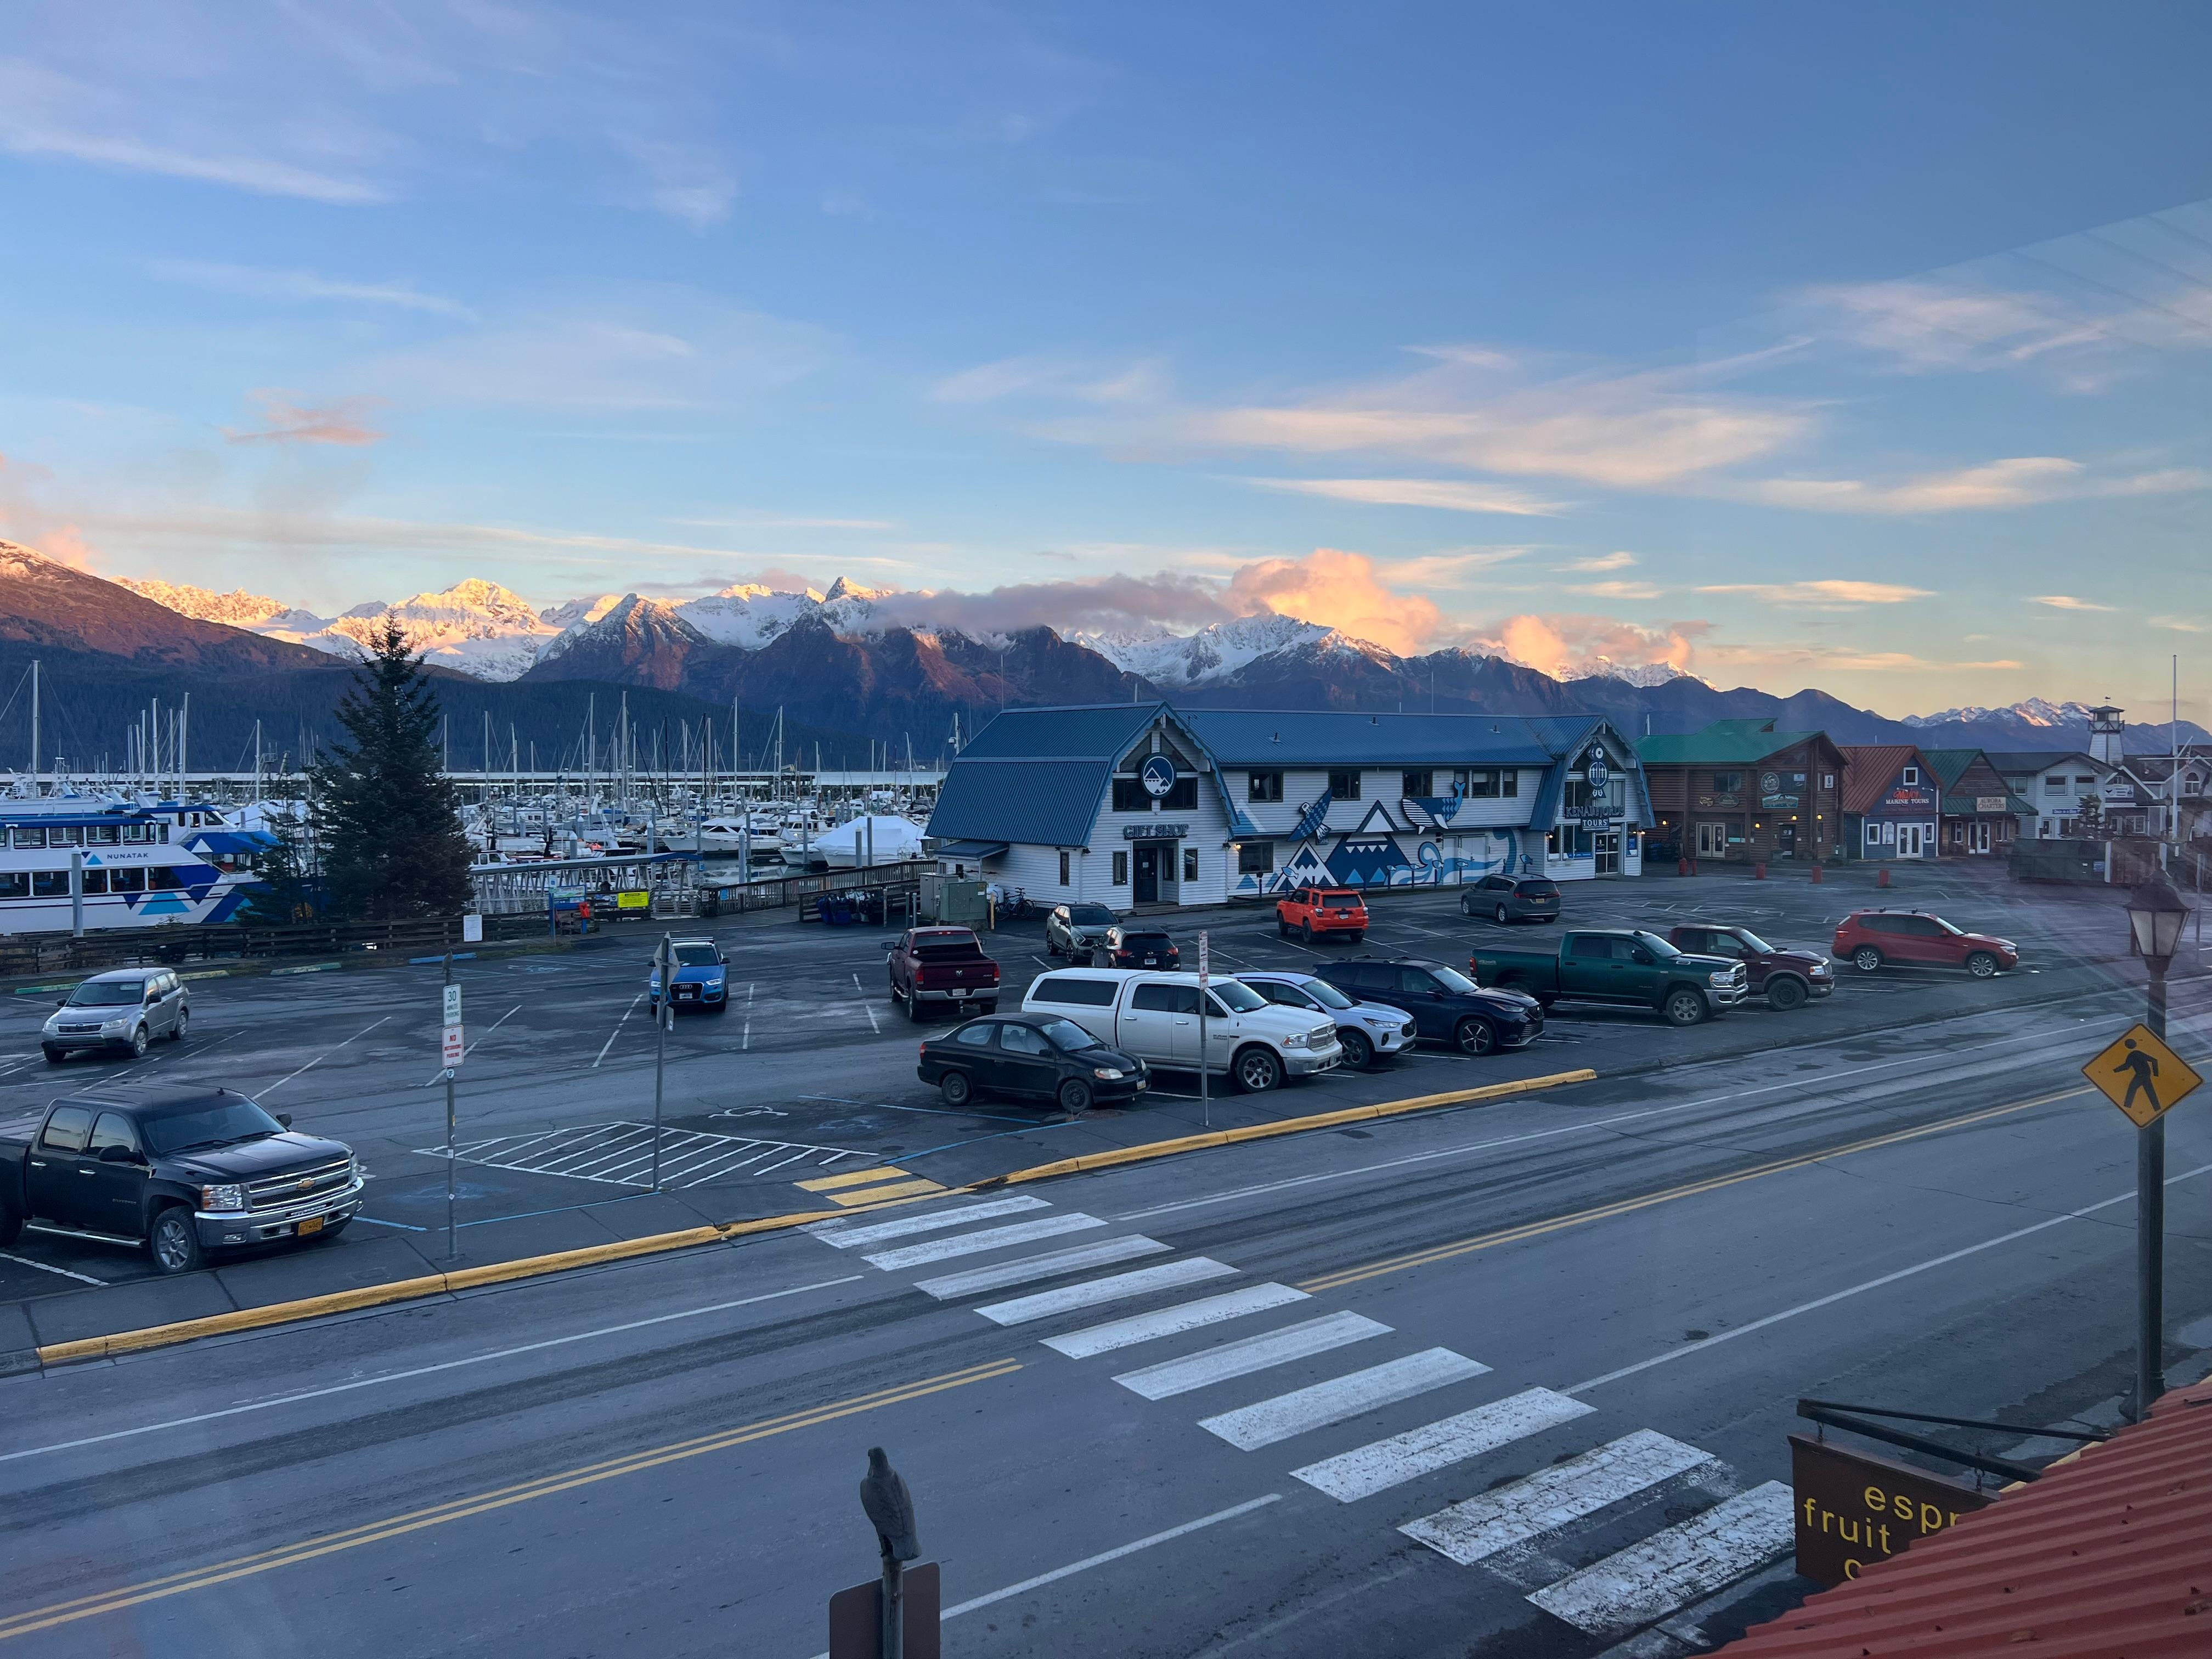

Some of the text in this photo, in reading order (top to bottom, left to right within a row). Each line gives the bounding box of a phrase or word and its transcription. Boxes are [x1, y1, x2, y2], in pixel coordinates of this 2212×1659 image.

[1565, 806, 1595, 817] KENAI
[1124, 823, 1189, 838] GIFT SHOP
[448, 991, 456, 1002] 30
[1804, 1498, 1891, 1554] fruit
